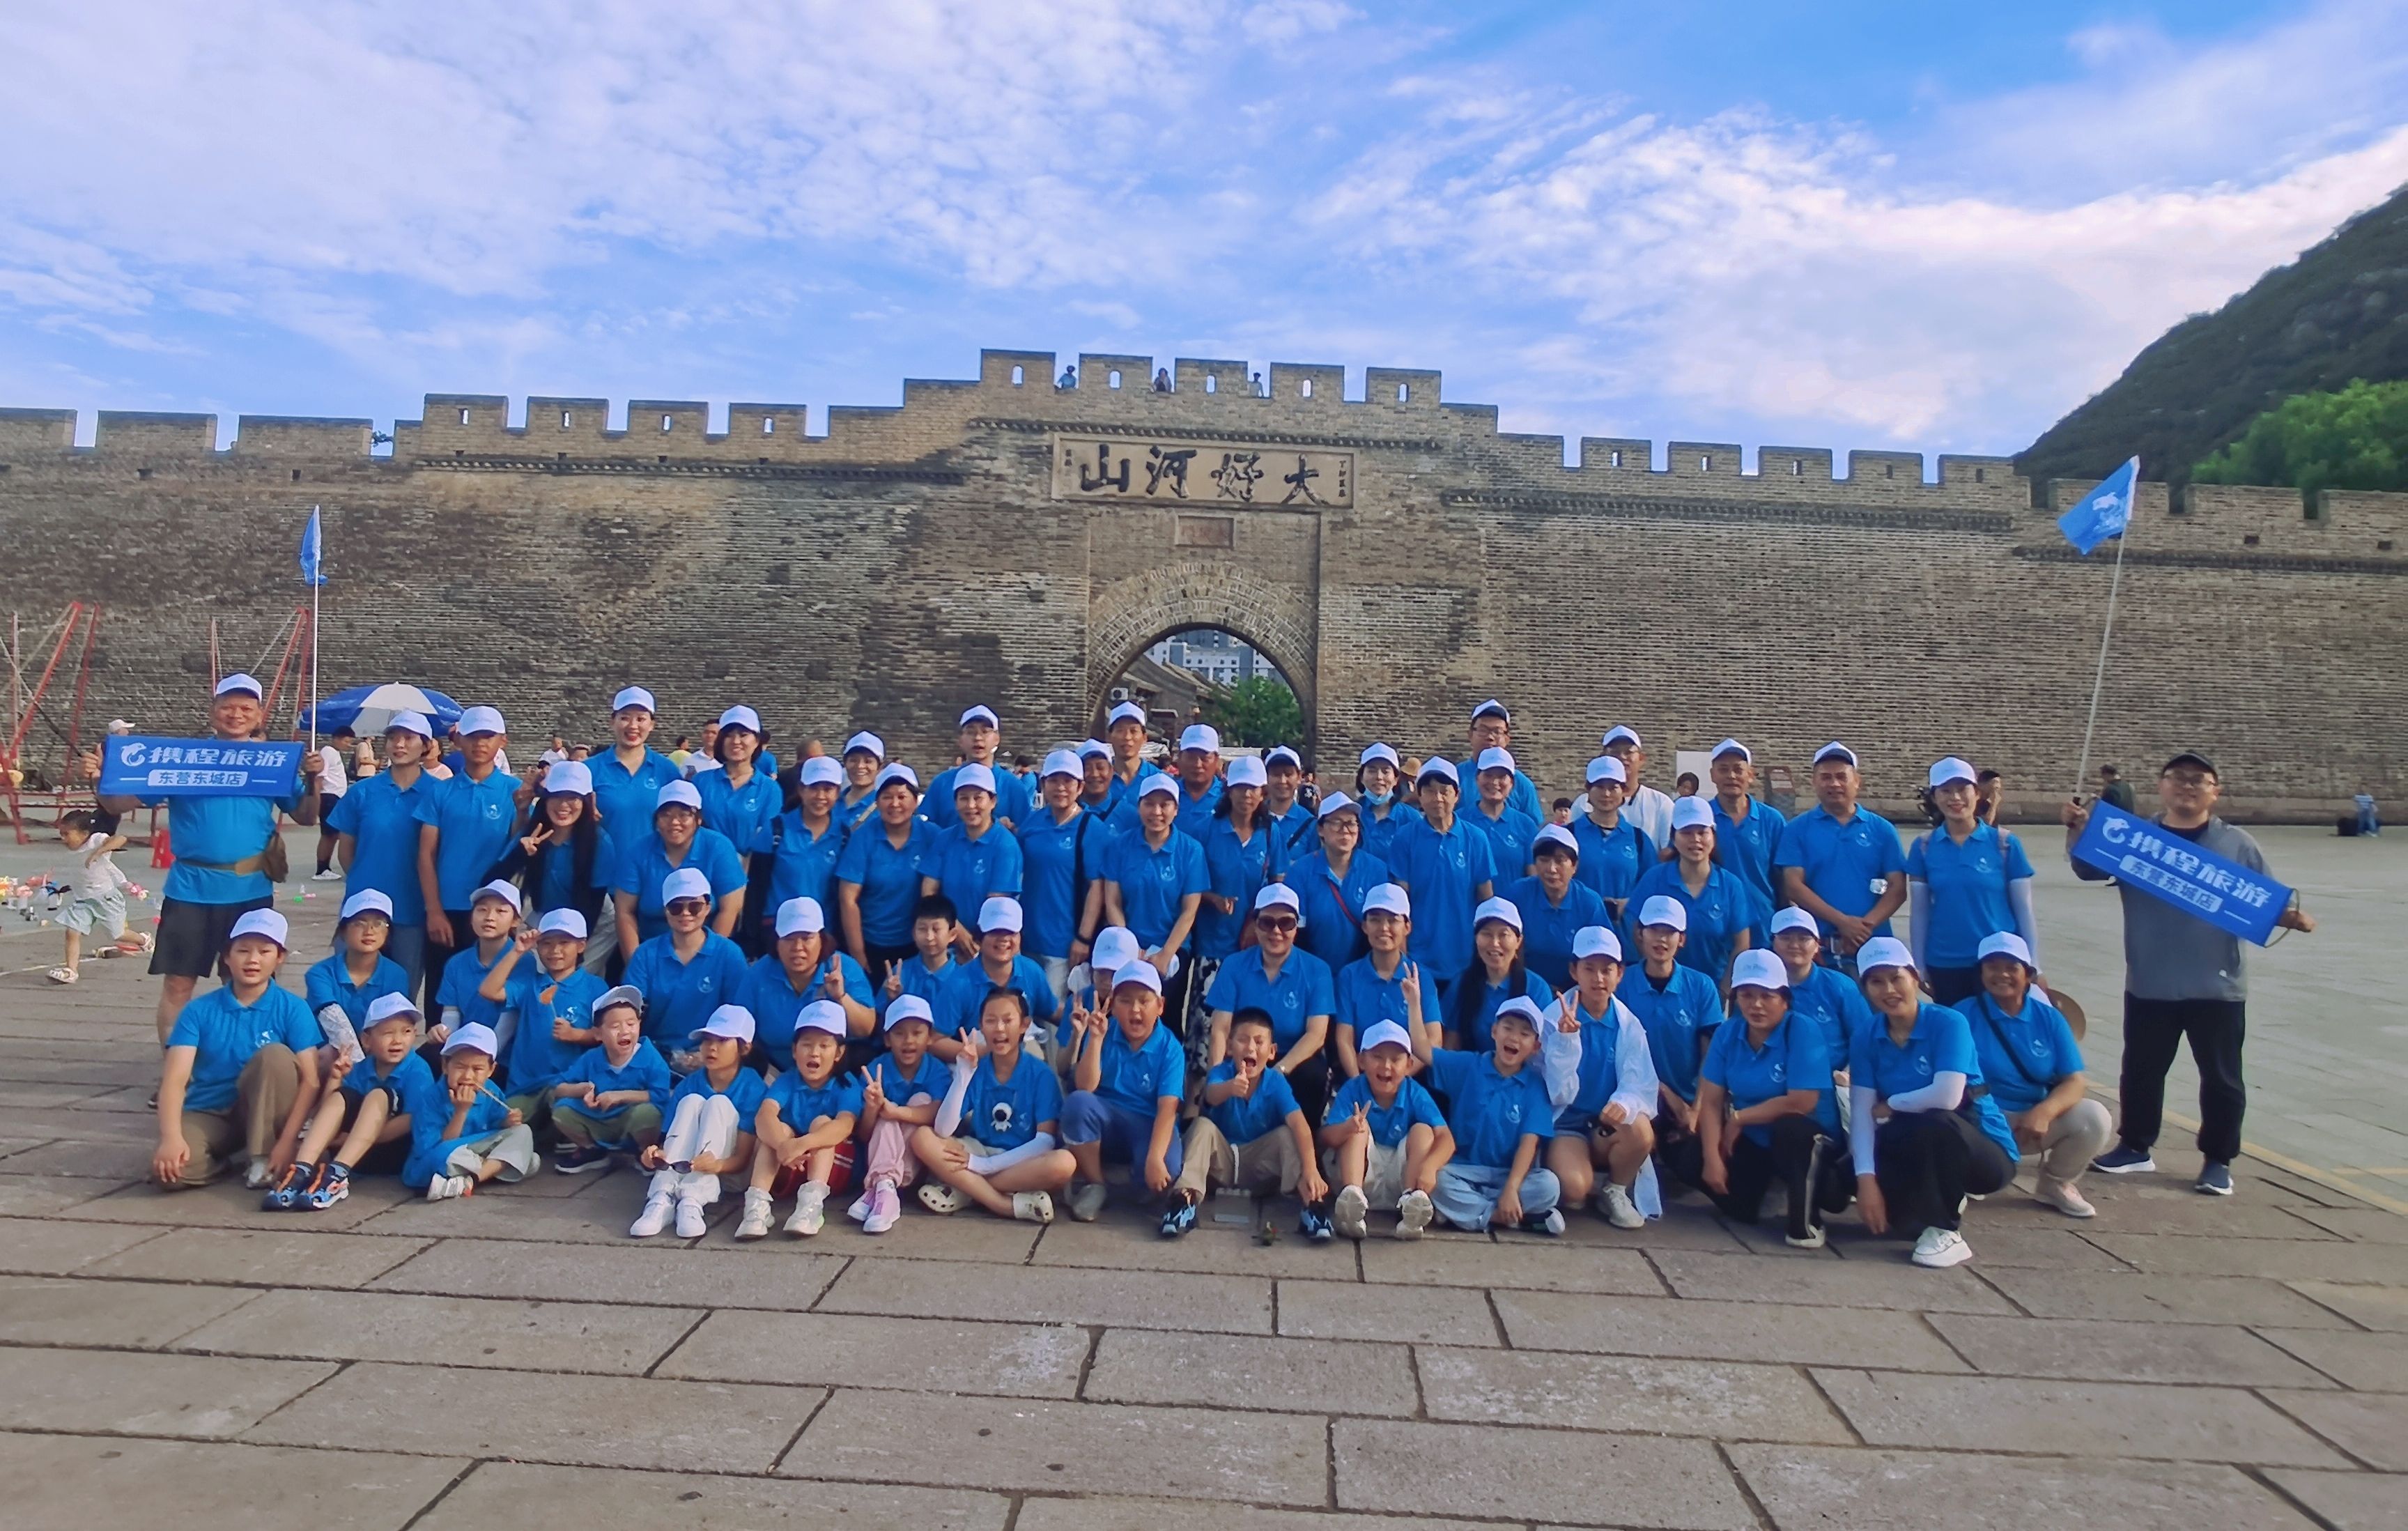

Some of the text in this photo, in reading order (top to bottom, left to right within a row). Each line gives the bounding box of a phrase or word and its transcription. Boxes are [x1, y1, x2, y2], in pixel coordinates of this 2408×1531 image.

[1080, 443, 1330, 505] 大好河山
[147, 746, 289, 768] 携程旅游
[158, 770, 243, 786] 东营东城店
[2127, 830, 2272, 908] 携程旅游
[2130, 861, 2216, 909] 东营东城店
